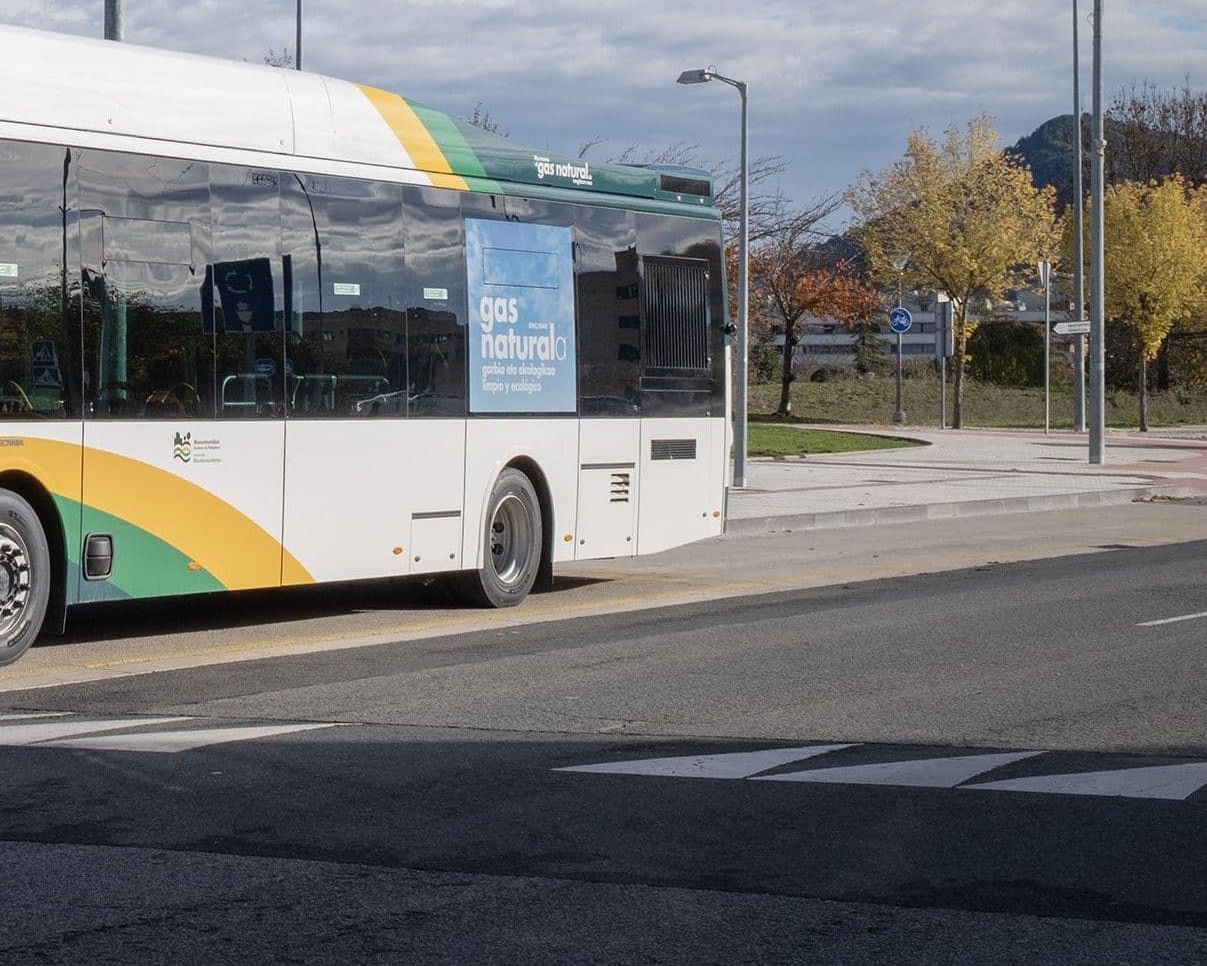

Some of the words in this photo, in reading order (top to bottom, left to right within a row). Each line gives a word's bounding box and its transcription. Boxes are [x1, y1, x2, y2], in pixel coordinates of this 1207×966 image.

[537, 161, 555, 179] gas
[480, 296, 519, 333] gas
[505, 364, 518, 375] eta
[504, 382, 510, 394] y
